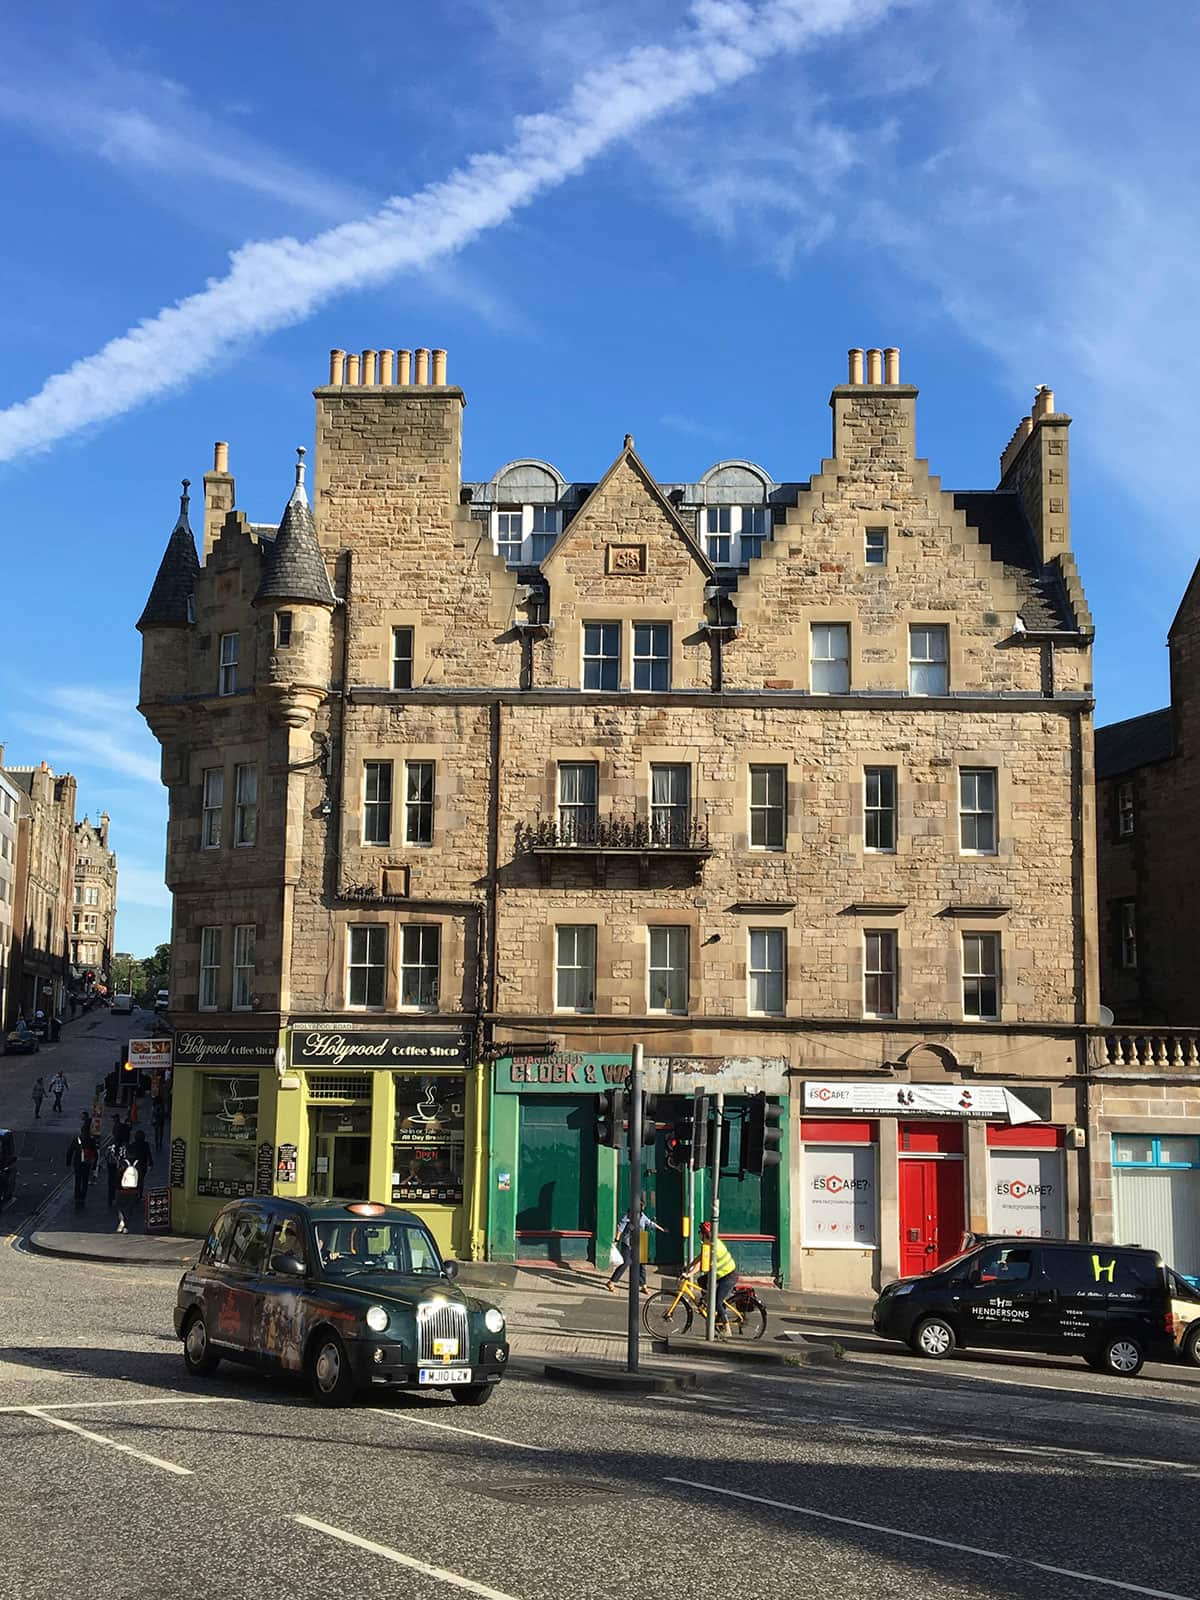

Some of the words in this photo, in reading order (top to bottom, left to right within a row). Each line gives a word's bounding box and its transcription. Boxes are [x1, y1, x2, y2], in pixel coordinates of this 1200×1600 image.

[178, 1033, 233, 1062] Holyrood
[231, 1046, 254, 1056] Coffee
[255, 1046, 275, 1056] Shop
[302, 1032, 390, 1064] Holyrood
[391, 1046, 428, 1056] Coffee
[429, 1046, 460, 1057] Shop
[510, 1064, 580, 1084] CLOCK
[584, 1064, 598, 1084] &
[415, 1150, 439, 1160] OPEN
[813, 1175, 868, 1194] ESCAPE?
[997, 1180, 1053, 1199] ESCAPE?
[1091, 1254, 1116, 1283] H
[996, 1297, 1006, 1308] H
[972, 1307, 1030, 1318] HENDERSONS
